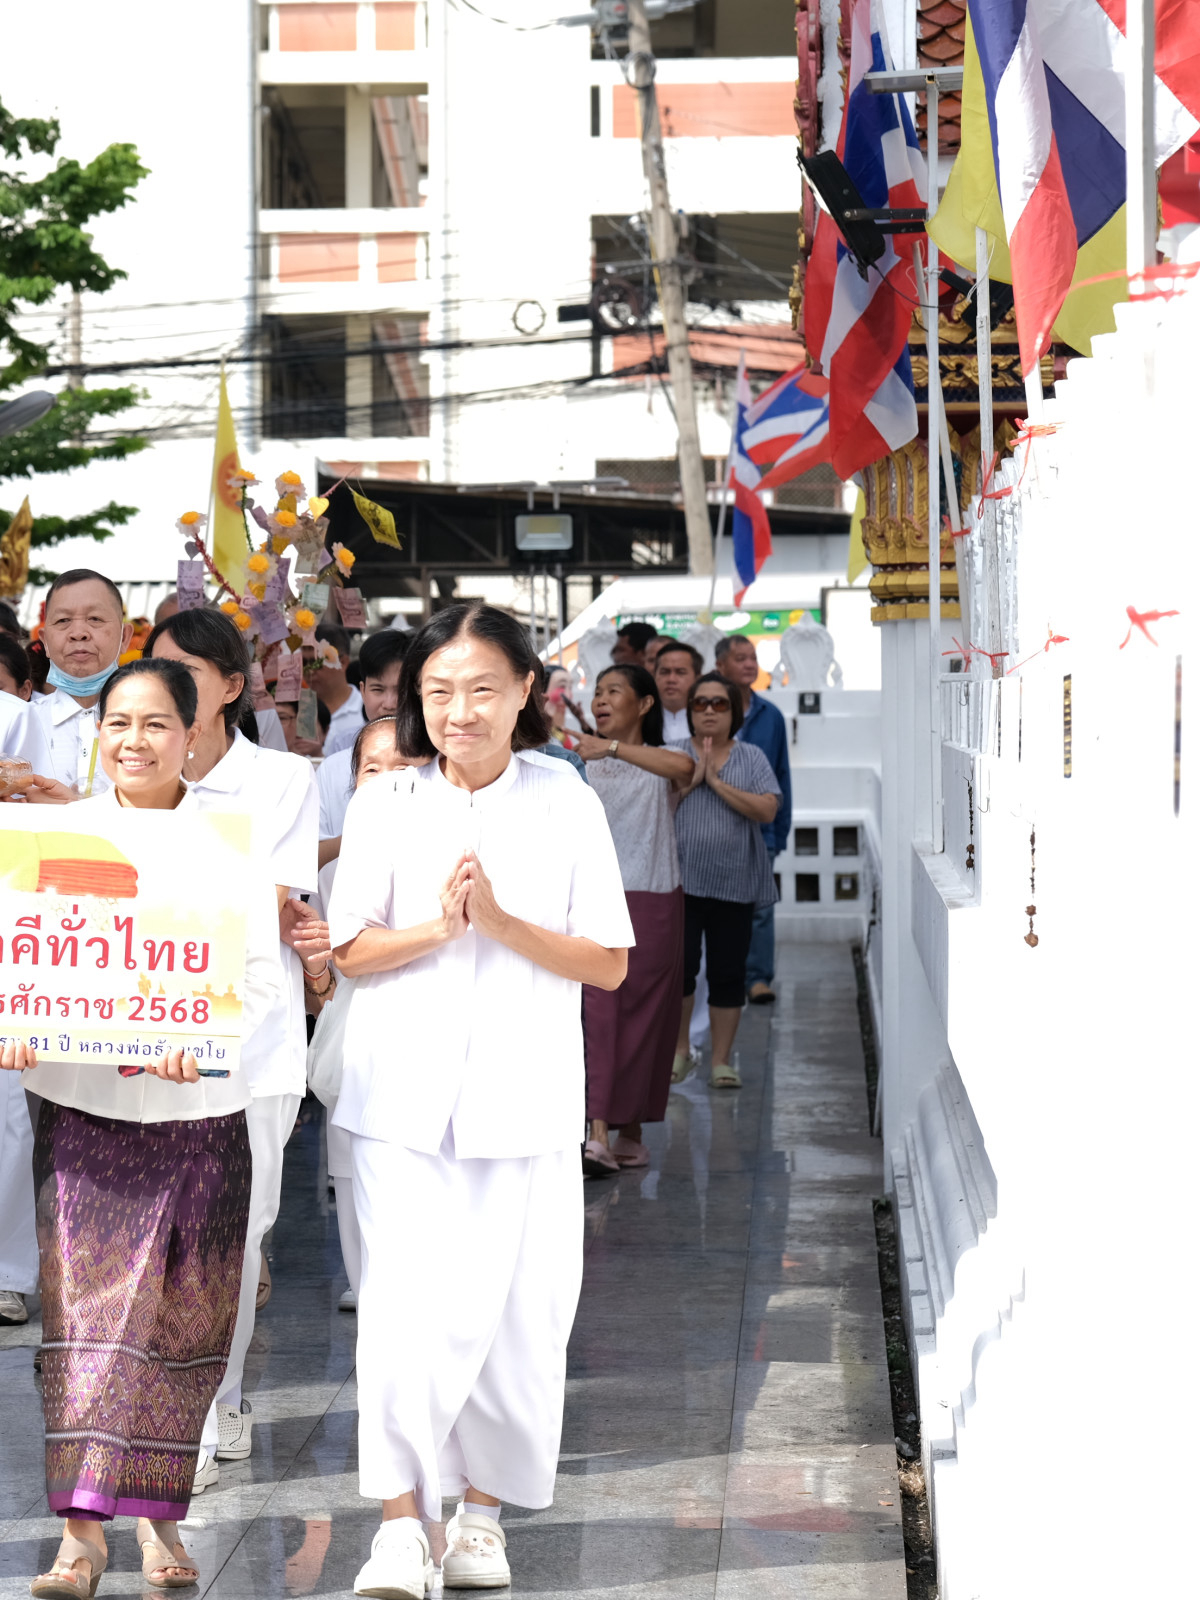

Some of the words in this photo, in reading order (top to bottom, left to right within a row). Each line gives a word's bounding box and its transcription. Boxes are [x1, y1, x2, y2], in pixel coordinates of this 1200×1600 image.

[127, 995, 210, 1024] 2568
[28, 1036, 50, 1051] 81
[58, 1033, 71, 1052] ปี
[78, 1038, 226, 1059] หลวงพ่อธัชโย
